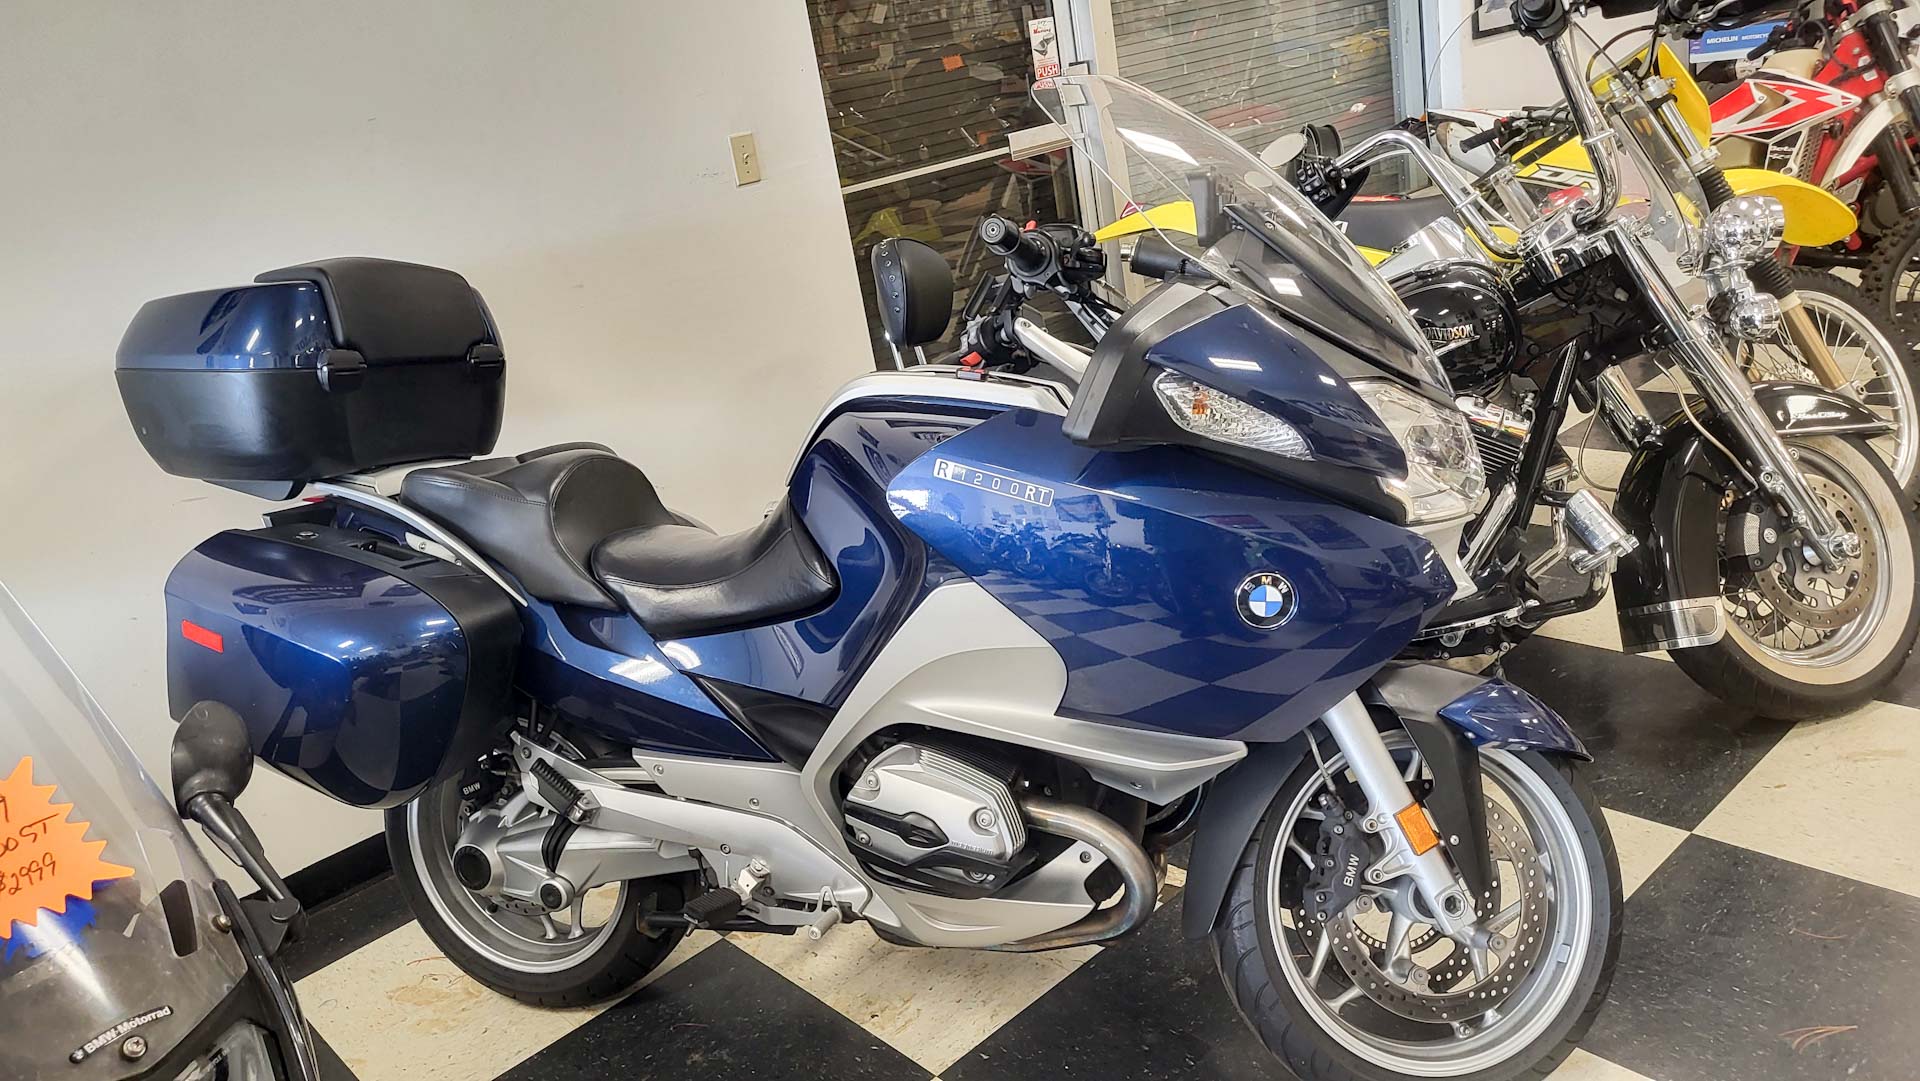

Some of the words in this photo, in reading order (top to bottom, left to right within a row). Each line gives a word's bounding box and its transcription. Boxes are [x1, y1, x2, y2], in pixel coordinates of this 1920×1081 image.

[1707, 35, 1738, 44] MICHELIN
[1037, 65, 1058, 78] PUSH
[1243, 575, 1290, 594] BMW
[462, 782, 481, 796] BMW
[1343, 853, 1360, 887] BMW
